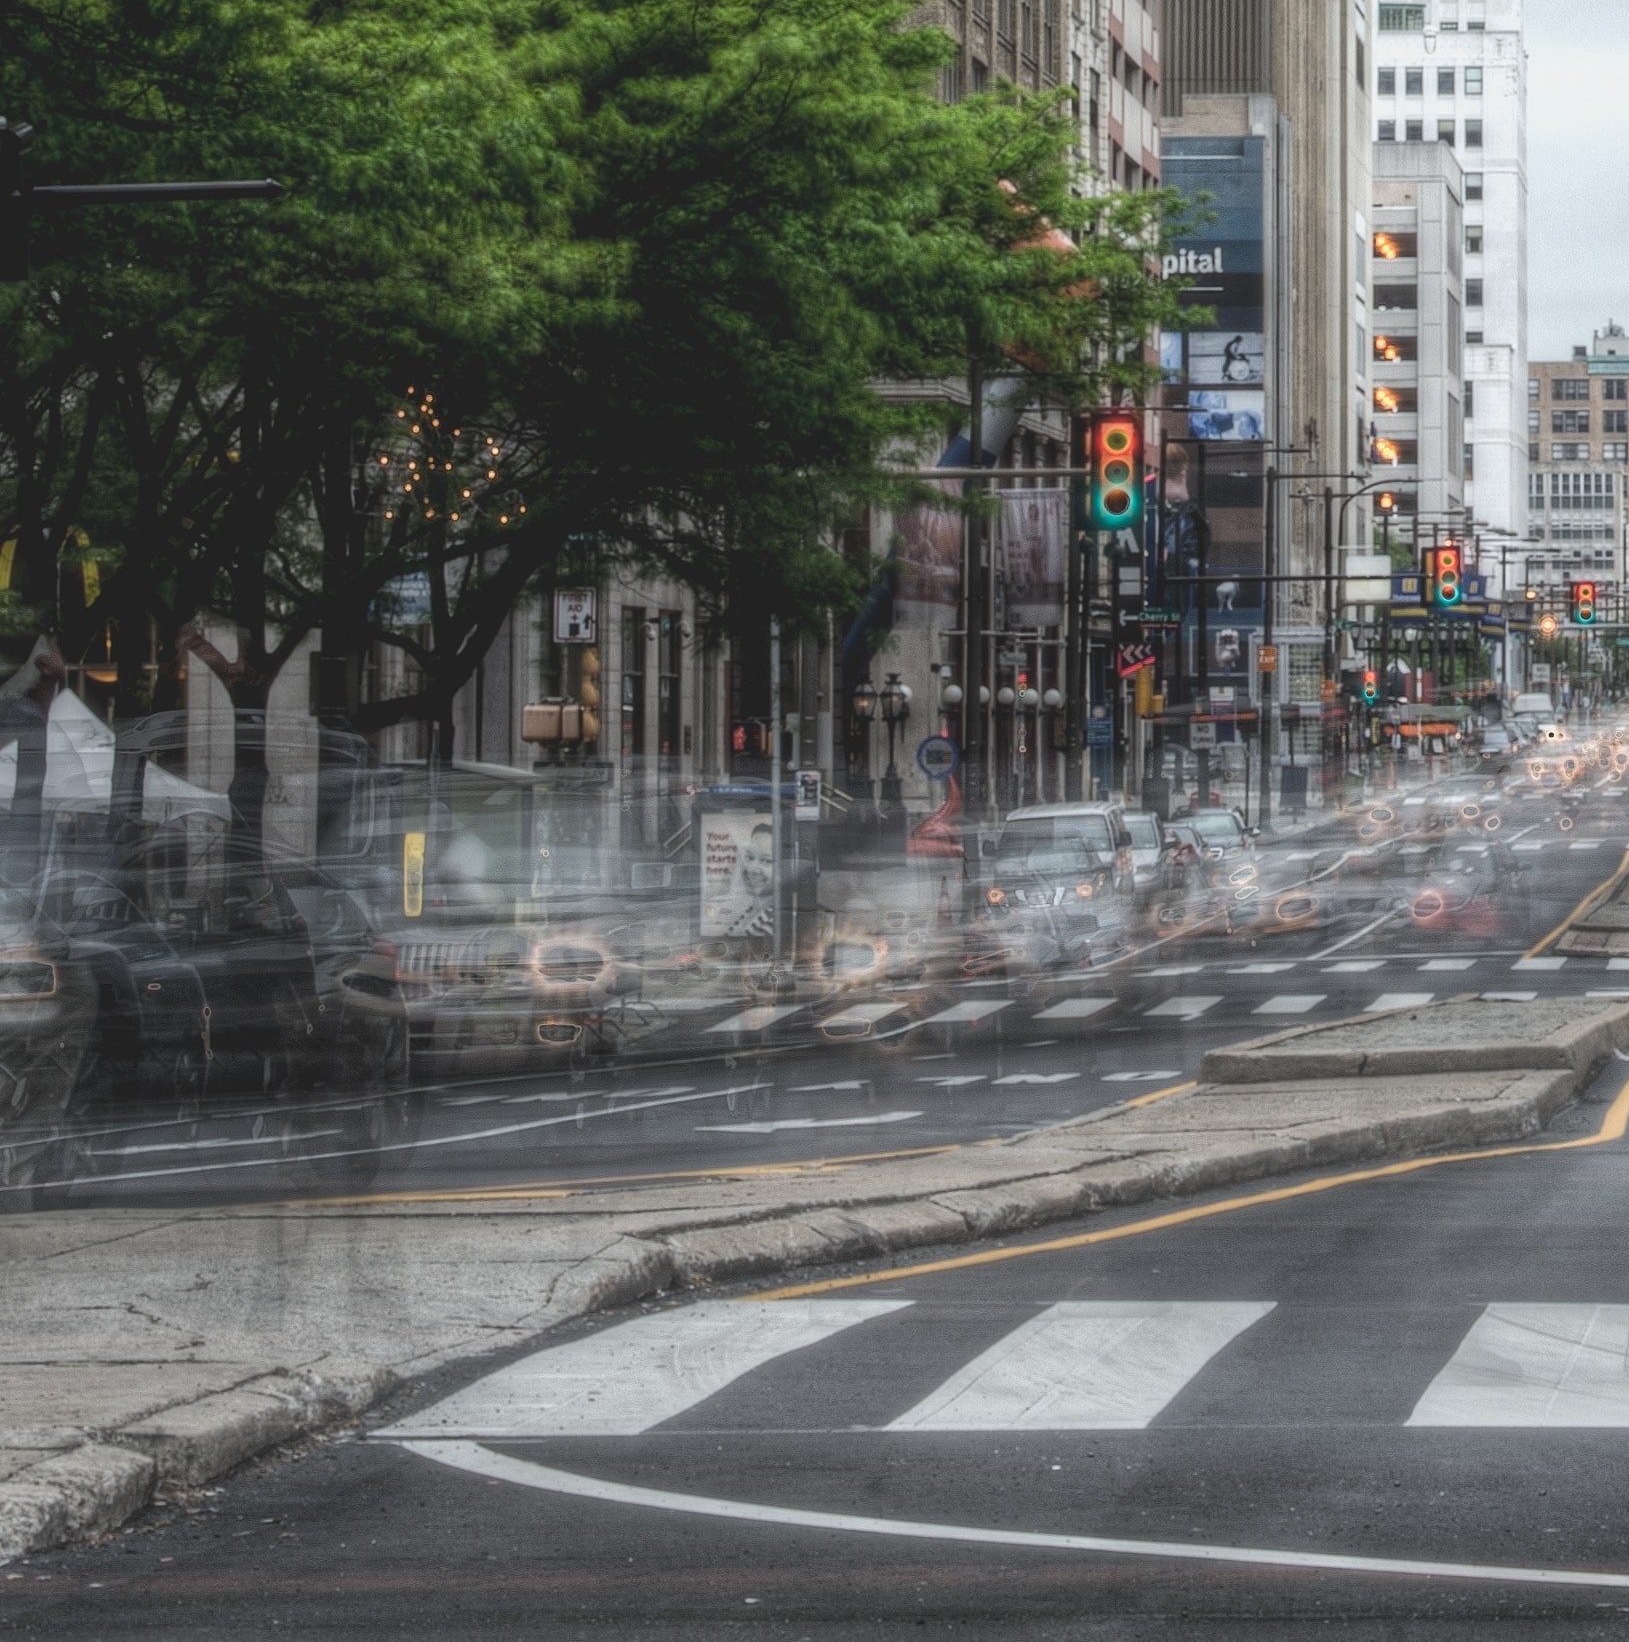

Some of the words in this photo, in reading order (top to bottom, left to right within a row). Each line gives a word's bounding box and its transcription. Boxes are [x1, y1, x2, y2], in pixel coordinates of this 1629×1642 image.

[1162, 246, 1223, 280] pital
[1140, 612, 1168, 622] Cherry
[706, 831, 730, 841] Your
[706, 843, 737, 852] future
[706, 855, 737, 864] starts
[706, 866, 732, 875] here.
